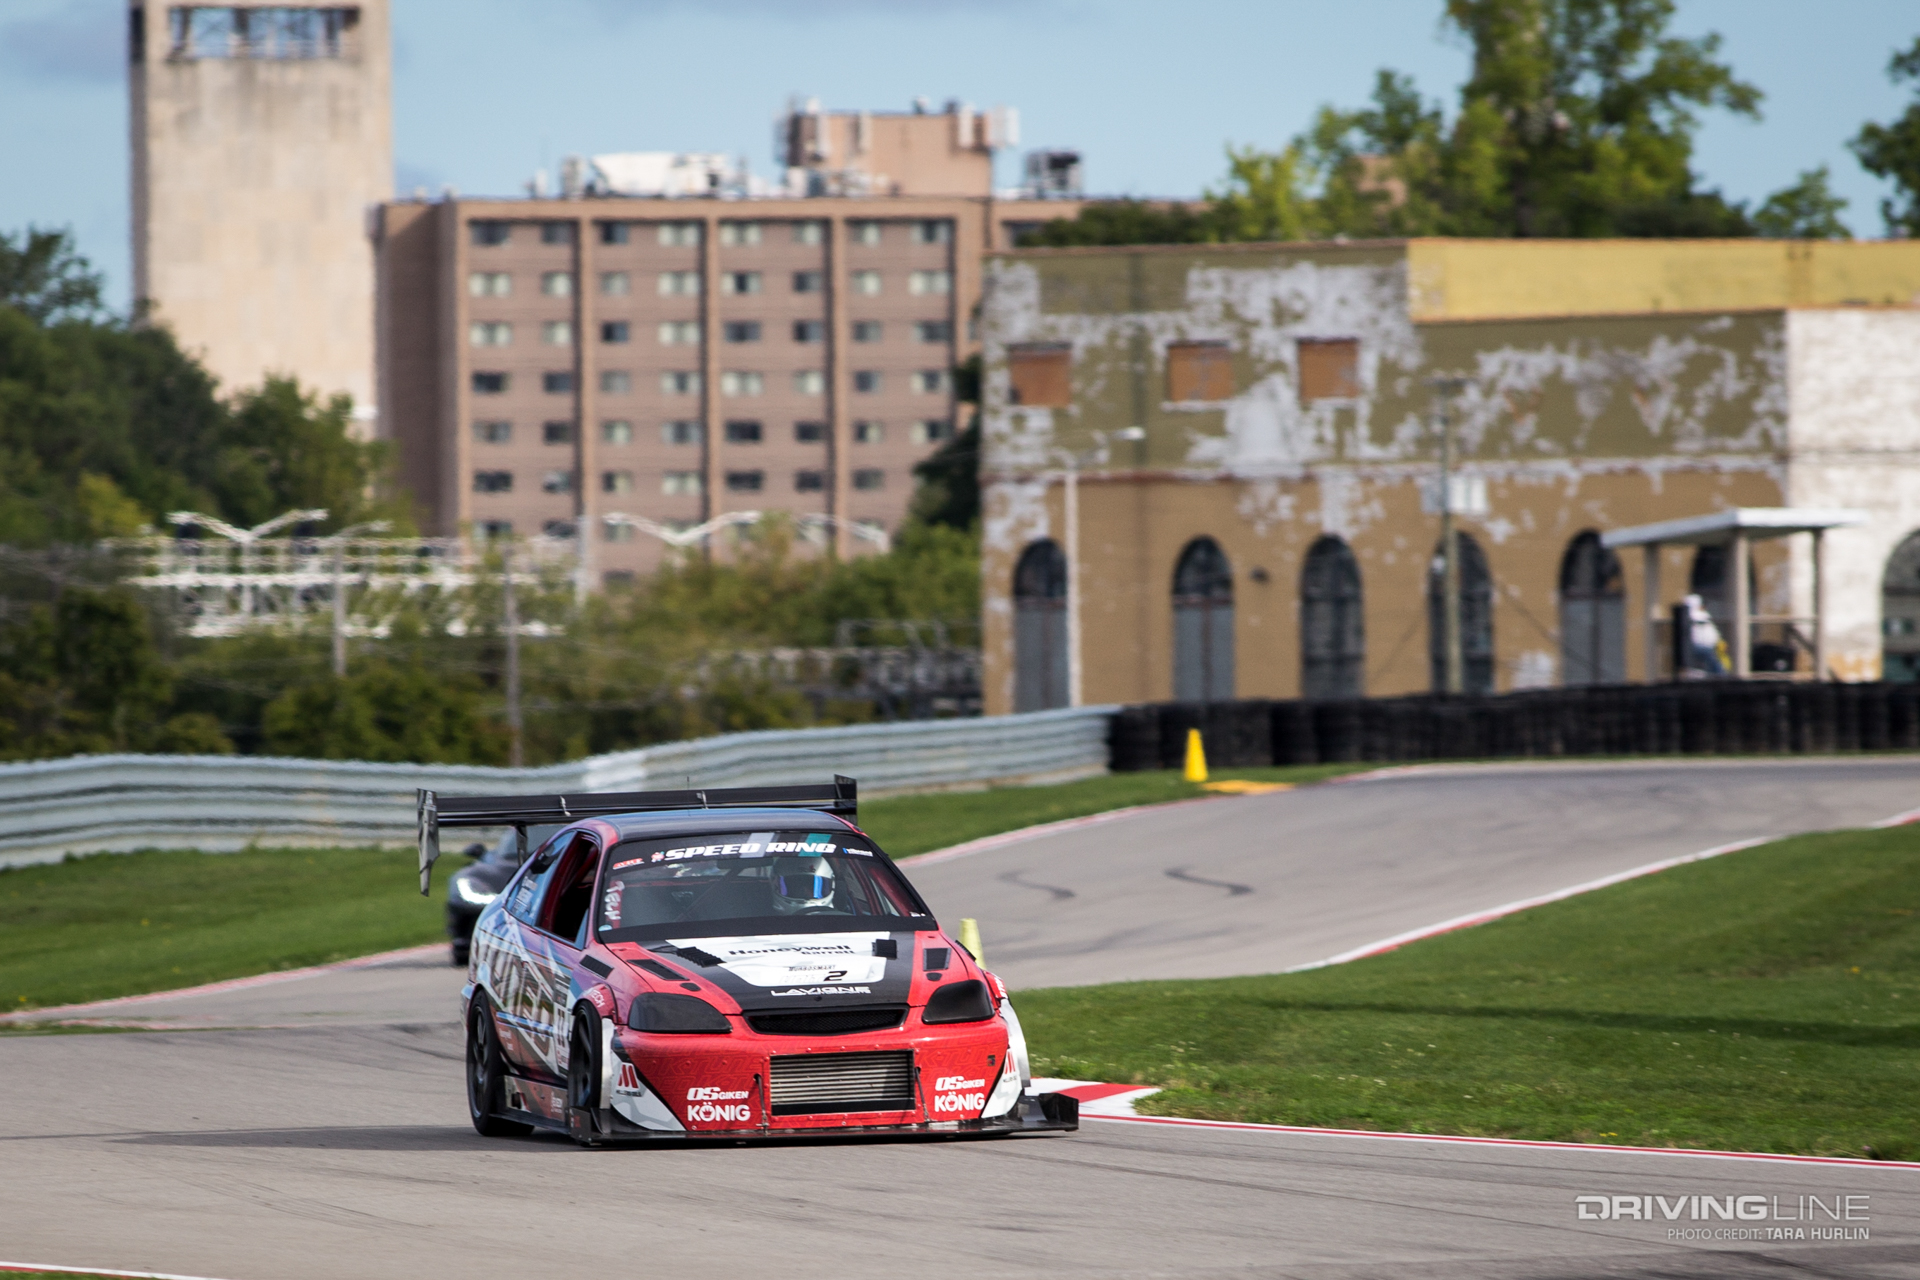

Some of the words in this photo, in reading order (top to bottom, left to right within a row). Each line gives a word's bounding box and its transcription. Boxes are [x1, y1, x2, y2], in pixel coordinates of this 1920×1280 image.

[664, 842, 762, 861] SPEED
[765, 842, 837, 853] RING
[728, 945, 851, 956] Honeywell
[823, 970, 848, 982] 2
[934, 1091, 985, 1112] KÖNIG
[687, 1102, 751, 1122] KÖNIG
